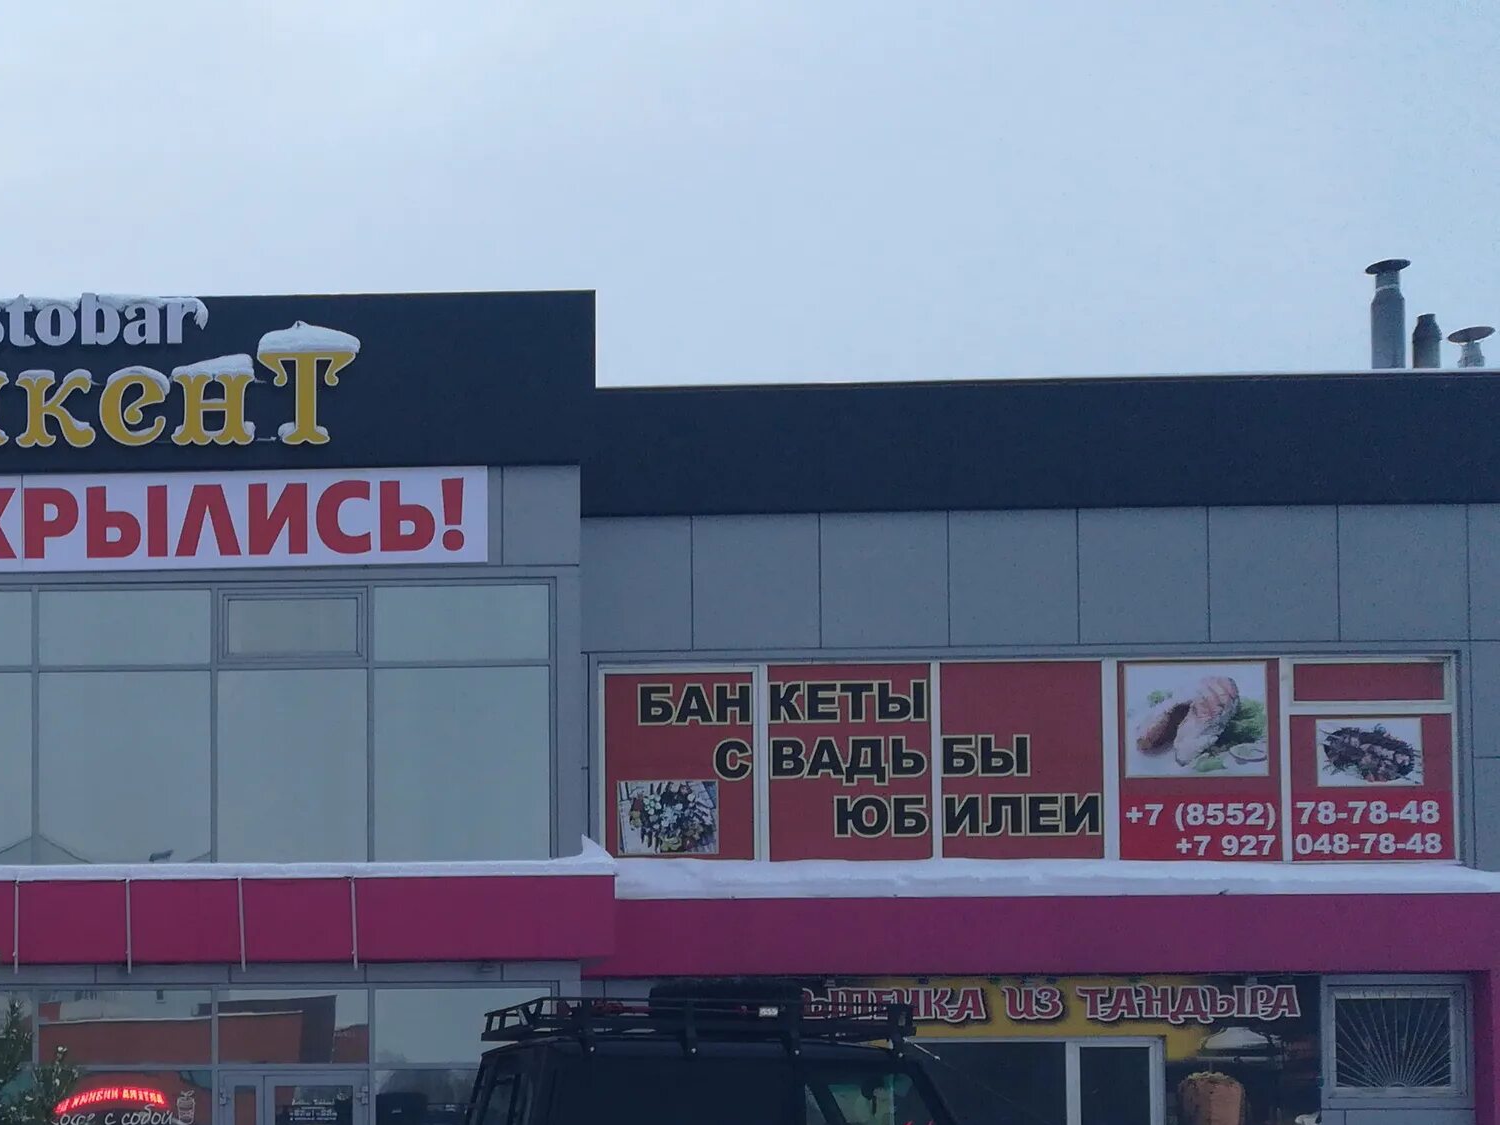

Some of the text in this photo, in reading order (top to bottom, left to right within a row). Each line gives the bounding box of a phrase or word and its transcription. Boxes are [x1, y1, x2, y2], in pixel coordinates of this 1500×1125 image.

[1125, 801, 1441, 831] +7 (8552) 78-78-48
[1176, 833, 1443, 856] +7 927 048-78-48
[1002, 985, 1064, 1020] ИЗ
[1075, 985, 1302, 1025] ТАНДЫРА
[104, 1112, 117, 1125] с
